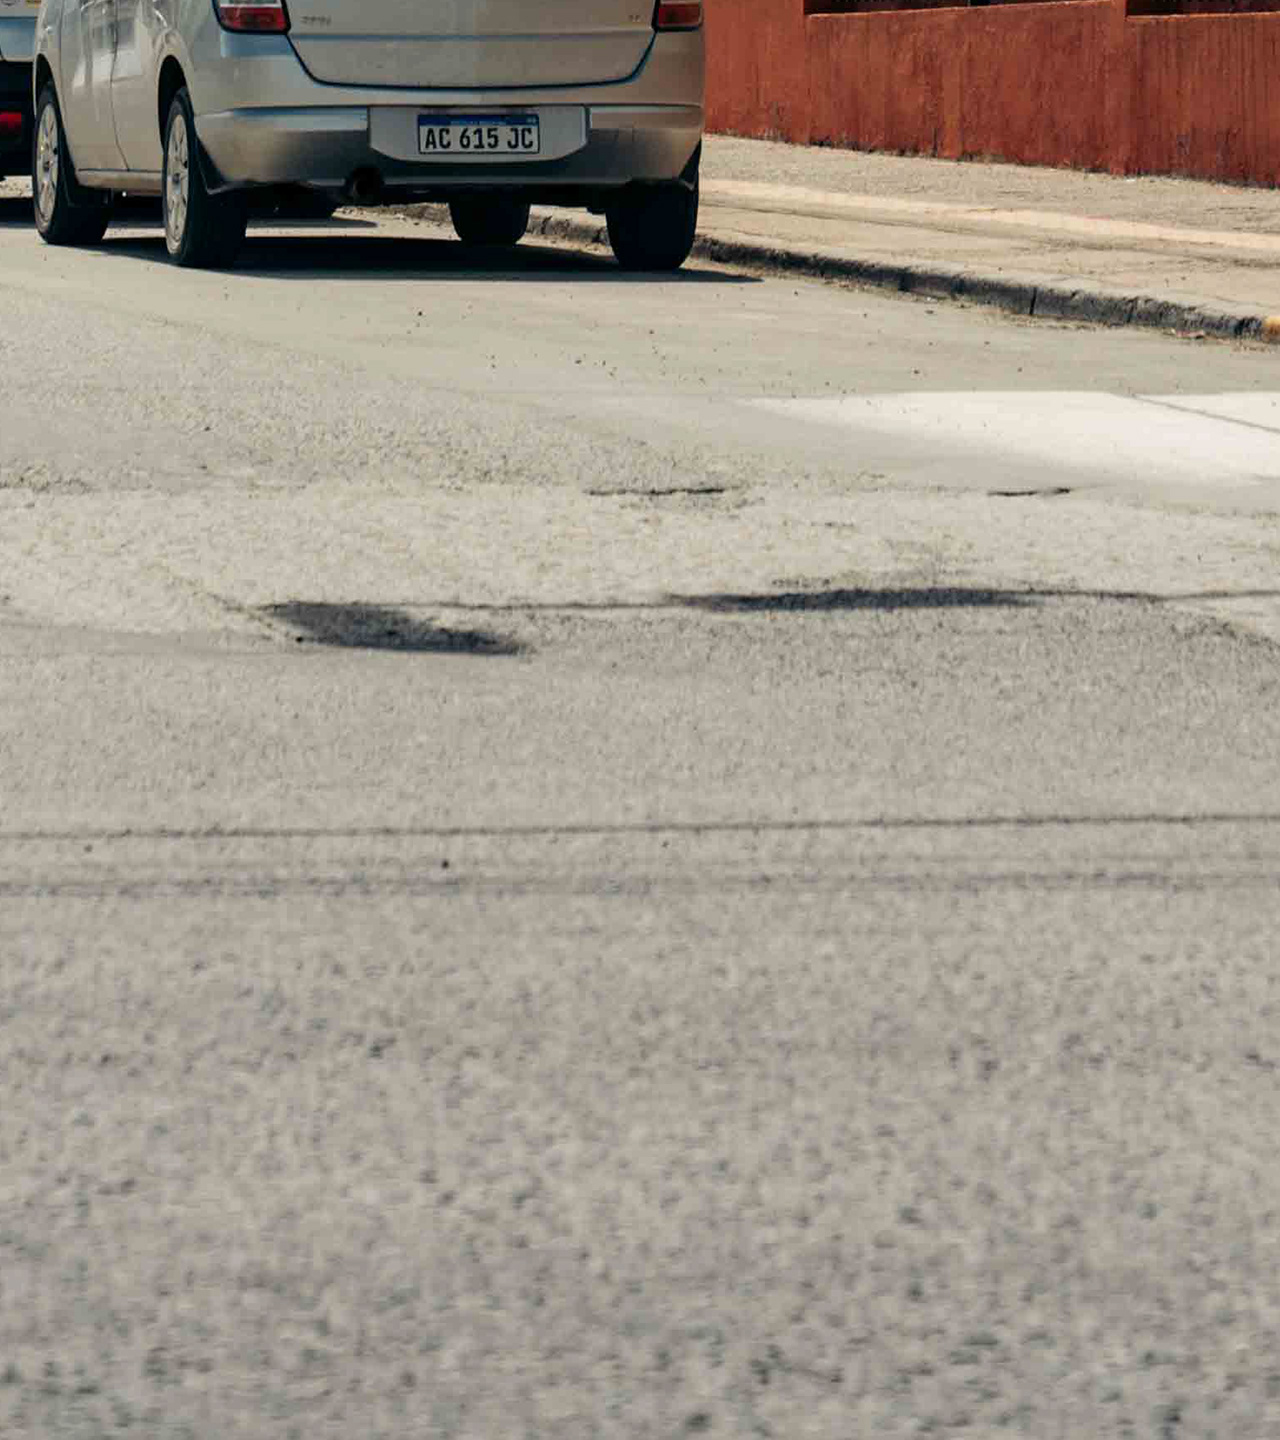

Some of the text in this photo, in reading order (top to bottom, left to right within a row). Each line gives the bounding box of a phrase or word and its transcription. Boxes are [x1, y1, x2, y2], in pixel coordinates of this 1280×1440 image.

[425, 127, 533, 149] AC 615 JC
